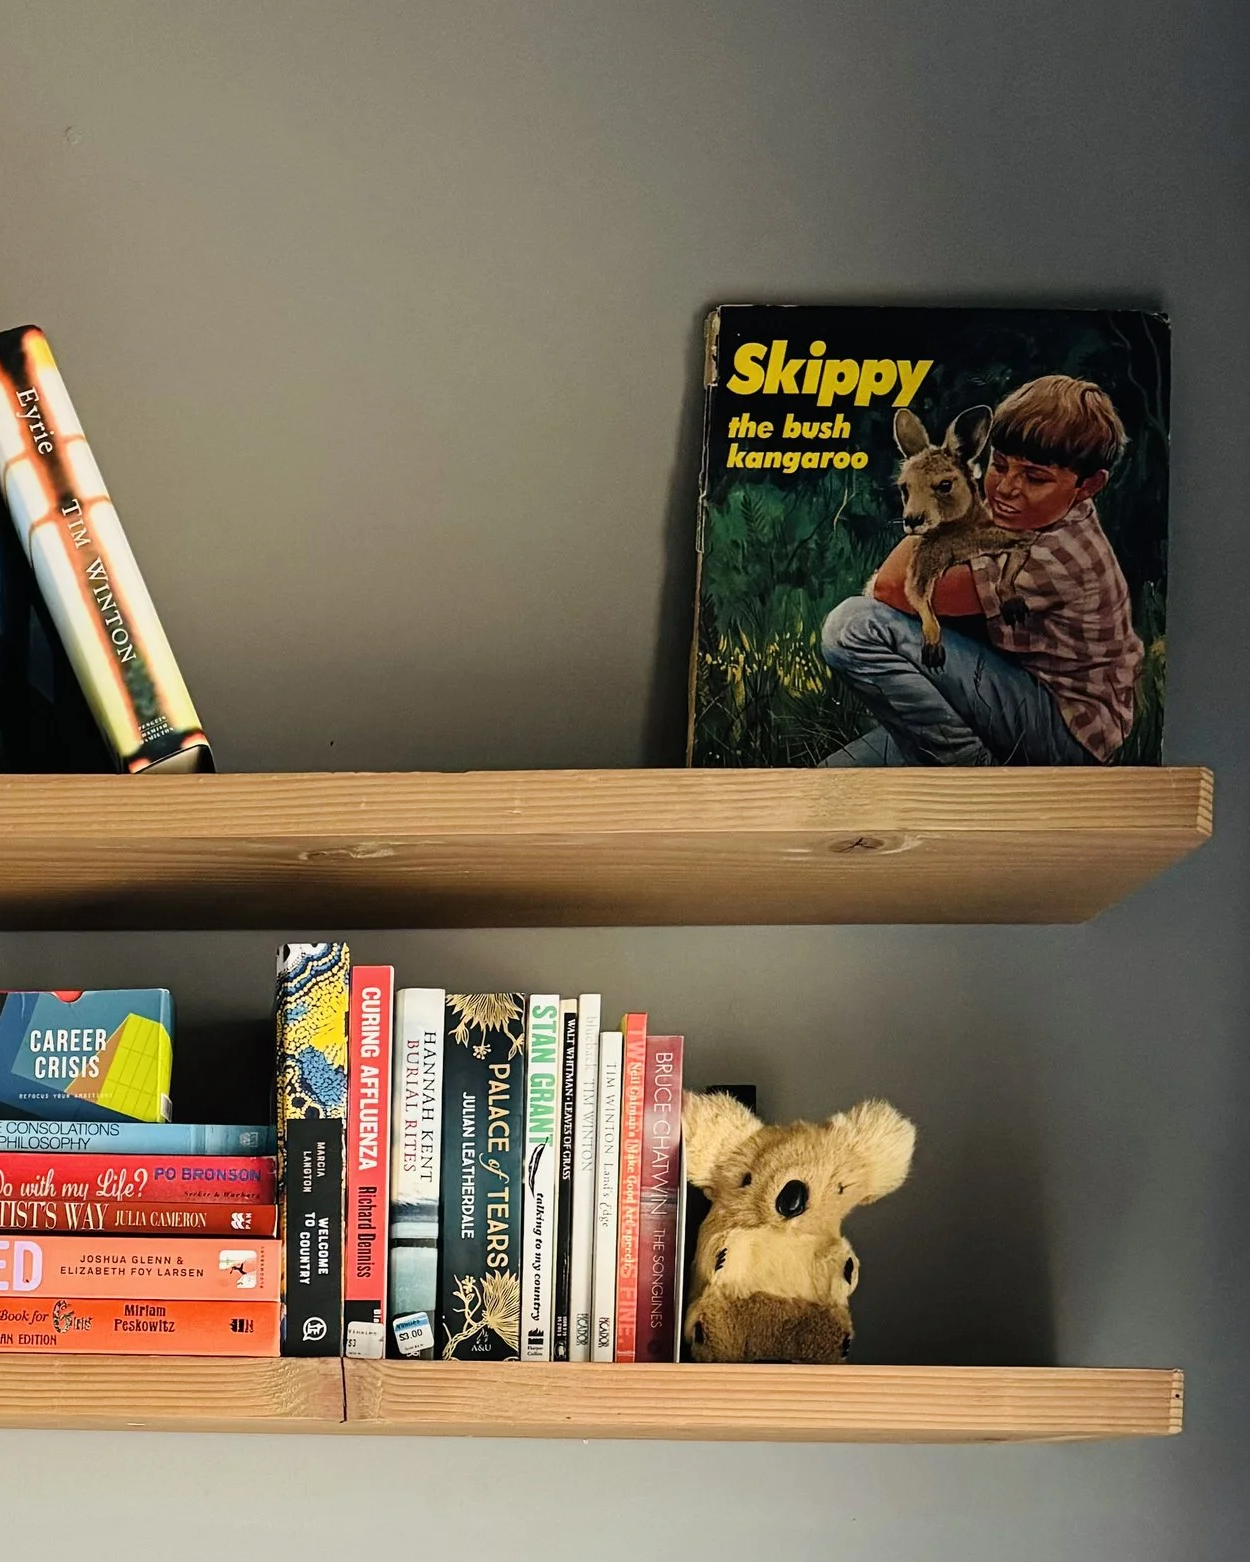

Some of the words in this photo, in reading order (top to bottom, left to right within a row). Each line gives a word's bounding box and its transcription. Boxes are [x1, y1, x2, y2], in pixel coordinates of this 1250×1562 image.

[725, 340, 933, 407] Skippy
[15, 387, 53, 455] Eyrie
[727, 413, 775, 440] the
[782, 415, 851, 440] bush
[725, 449, 869, 475] kangaroo
[61, 499, 91, 549] TIM
[85, 556, 137, 664] WINTON
[30, 1028, 108, 1052] CAREER
[360, 987, 382, 1058] CURING
[531, 1004, 557, 1064] STAN
[566, 1018, 576, 1045] WALT
[584, 1015, 598, 1070] blueback
[35, 1056, 101, 1079] CRISIS
[405, 1039, 420, 1113] BURIAL
[421, 1031, 437, 1122] HANNAH
[565, 1046, 575, 1097] WHITMAN
[605, 1062, 617, 1089] TIM
[629, 1062, 642, 1085] Neil
[653, 1052, 673, 1113] BRUCE
[487, 1062, 511, 1153] PALACE
[529, 1072, 556, 1147] GRANT
[582, 1078, 595, 1106] TIM
[6, 1121, 120, 1137] CONSOLATIONS
[358, 1065, 380, 1171] AFFLUENZA
[462, 1091, 476, 1138] JULIAN
[563, 1101, 573, 1135] LEAVES
[604, 1094, 616, 1155] WINTON
[403, 1119, 417, 1173] RITES
[420, 1129, 434, 1183] KENT
[562, 1136, 572, 1150] OF
[580, 1109, 595, 1172] WINTON
[154, 1167, 176, 1181] PO
[181, 1167, 261, 1182] BRONSON
[302, 1151, 312, 1193] LANGTON
[316, 1141, 326, 1178] MARCIA
[478, 1152, 510, 1184] of
[561, 1150, 571, 1180] GRASS
[650, 1119, 671, 1215] CHATWIN
[20, 1168, 57, 1198] with
[61, 1180, 89, 1201] my
[95, 1167, 148, 1202] Life?
[461, 1142, 476, 1239] LEATHERDALE
[626, 1175, 638, 1203] Good
[64, 1201, 109, 1231] WAY
[114, 1210, 147, 1226] JULIA
[150, 1211, 207, 1228] CAMERON
[304, 1211, 316, 1227] TO
[357, 1186, 377, 1229] Richard
[533, 1192, 545, 1236] talking
[598, 1201, 612, 1228] Edge
[486, 1186, 509, 1268] TEARS
[534, 1238, 543, 1250] to
[652, 1228, 666, 1251] THE
[80, 1255, 127, 1265] JOSHUA
[131, 1256, 172, 1265] GLENN
[176, 1256, 184, 1265] &
[299, 1231, 311, 1285] COUNTRY
[318, 1217, 329, 1275] WELCOME
[356, 1233, 376, 1278] Denniss
[532, 1252, 543, 1271] my
[60, 1266, 126, 1276] ELIZABETH
[131, 1267, 152, 1277] FOY
[157, 1268, 204, 1278] LARSEN
[531, 1273, 543, 1322] country
[650, 1254, 665, 1329] SONGLINES
[31, 1310, 49, 1326] for
[114, 1317, 176, 1333] Peskowitz
[124, 1304, 166, 1316] Miriam
[618, 1287, 637, 1344] FINE.
[18, 1333, 57, 1346] EDITION
[399, 1329, 423, 1342] $3.00
[576, 1313, 589, 1346] PICADOR
[598, 1316, 610, 1348] PICADOR
